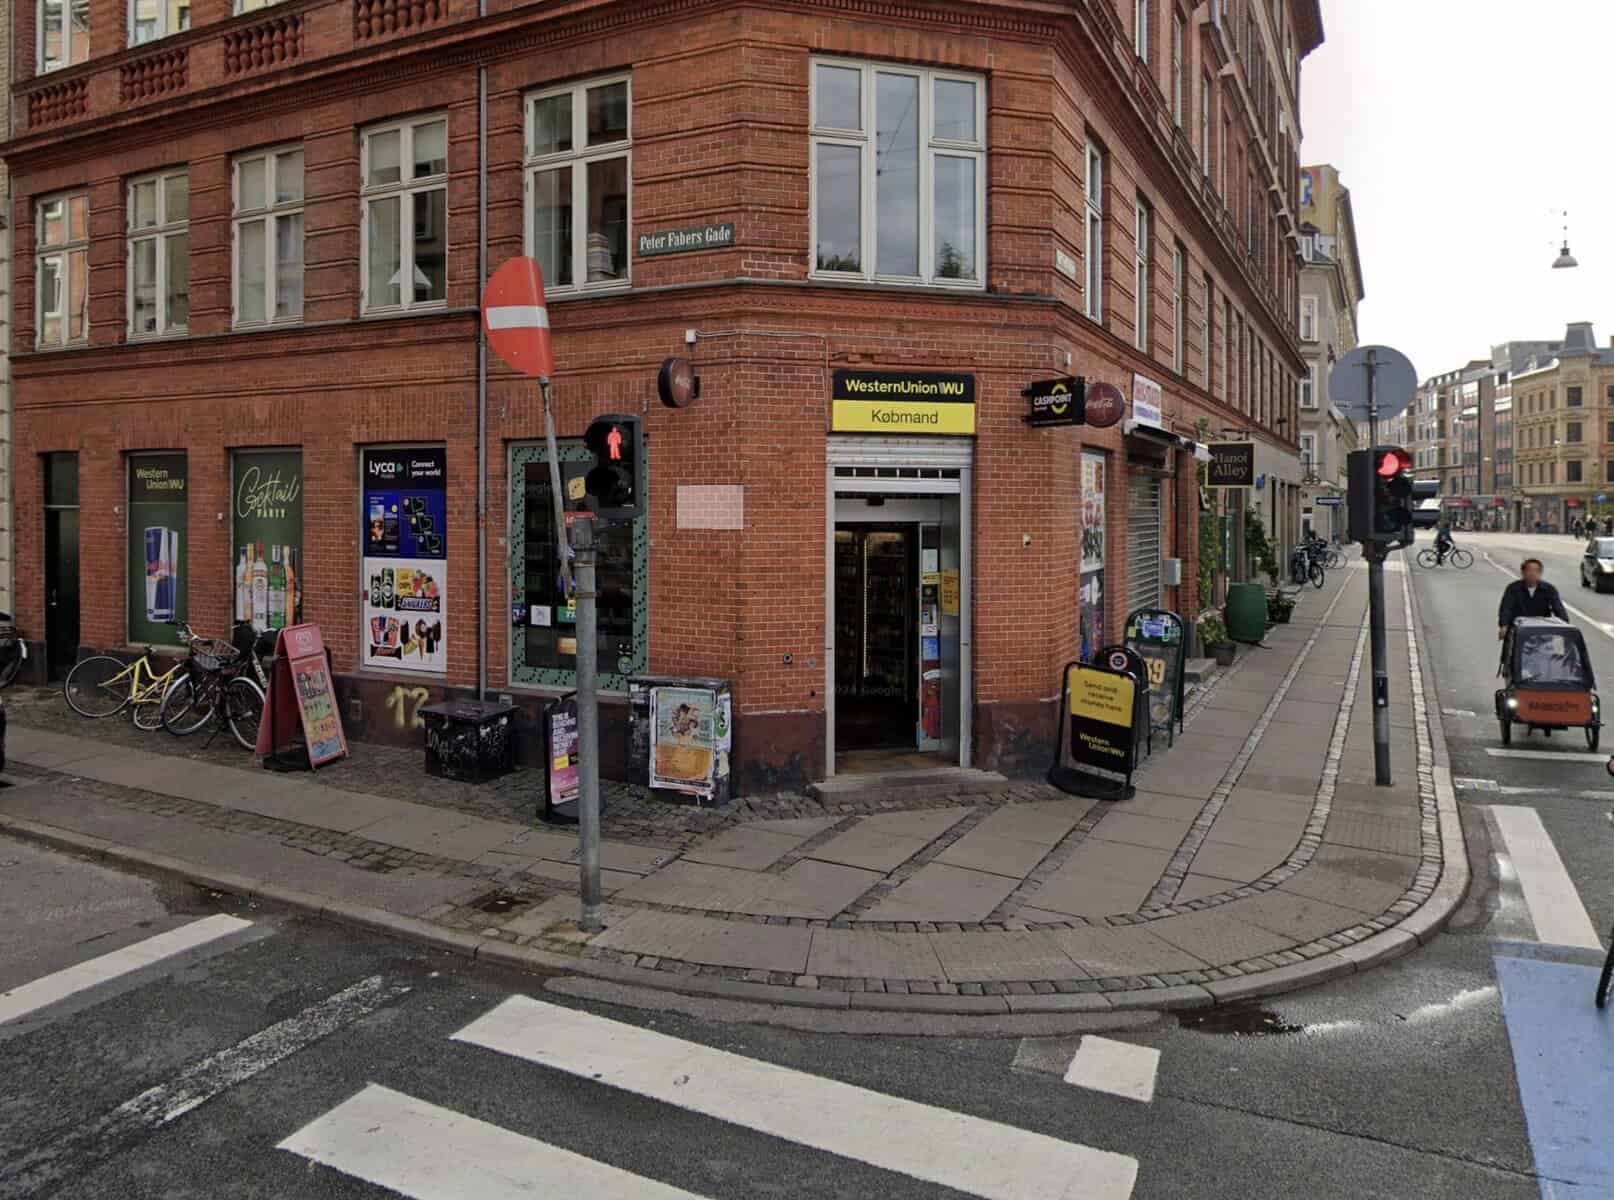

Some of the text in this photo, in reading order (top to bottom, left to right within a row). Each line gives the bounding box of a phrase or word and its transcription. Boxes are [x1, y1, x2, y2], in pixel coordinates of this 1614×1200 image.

[640, 225, 731, 250] Peter Fabers Gade
[871, 409, 938, 424] Købmand
[411, 460, 435, 468] Connect
[1215, 452, 1247, 464] Hanoi
[136, 468, 168, 481] Western
[369, 460, 395, 475] Lyca
[1214, 463, 1248, 480] Alley
[146, 477, 168, 489] Union
[237, 466, 299, 518] Cocktail
[256, 508, 285, 518] PARTY
[1079, 733, 1110, 747] Western
